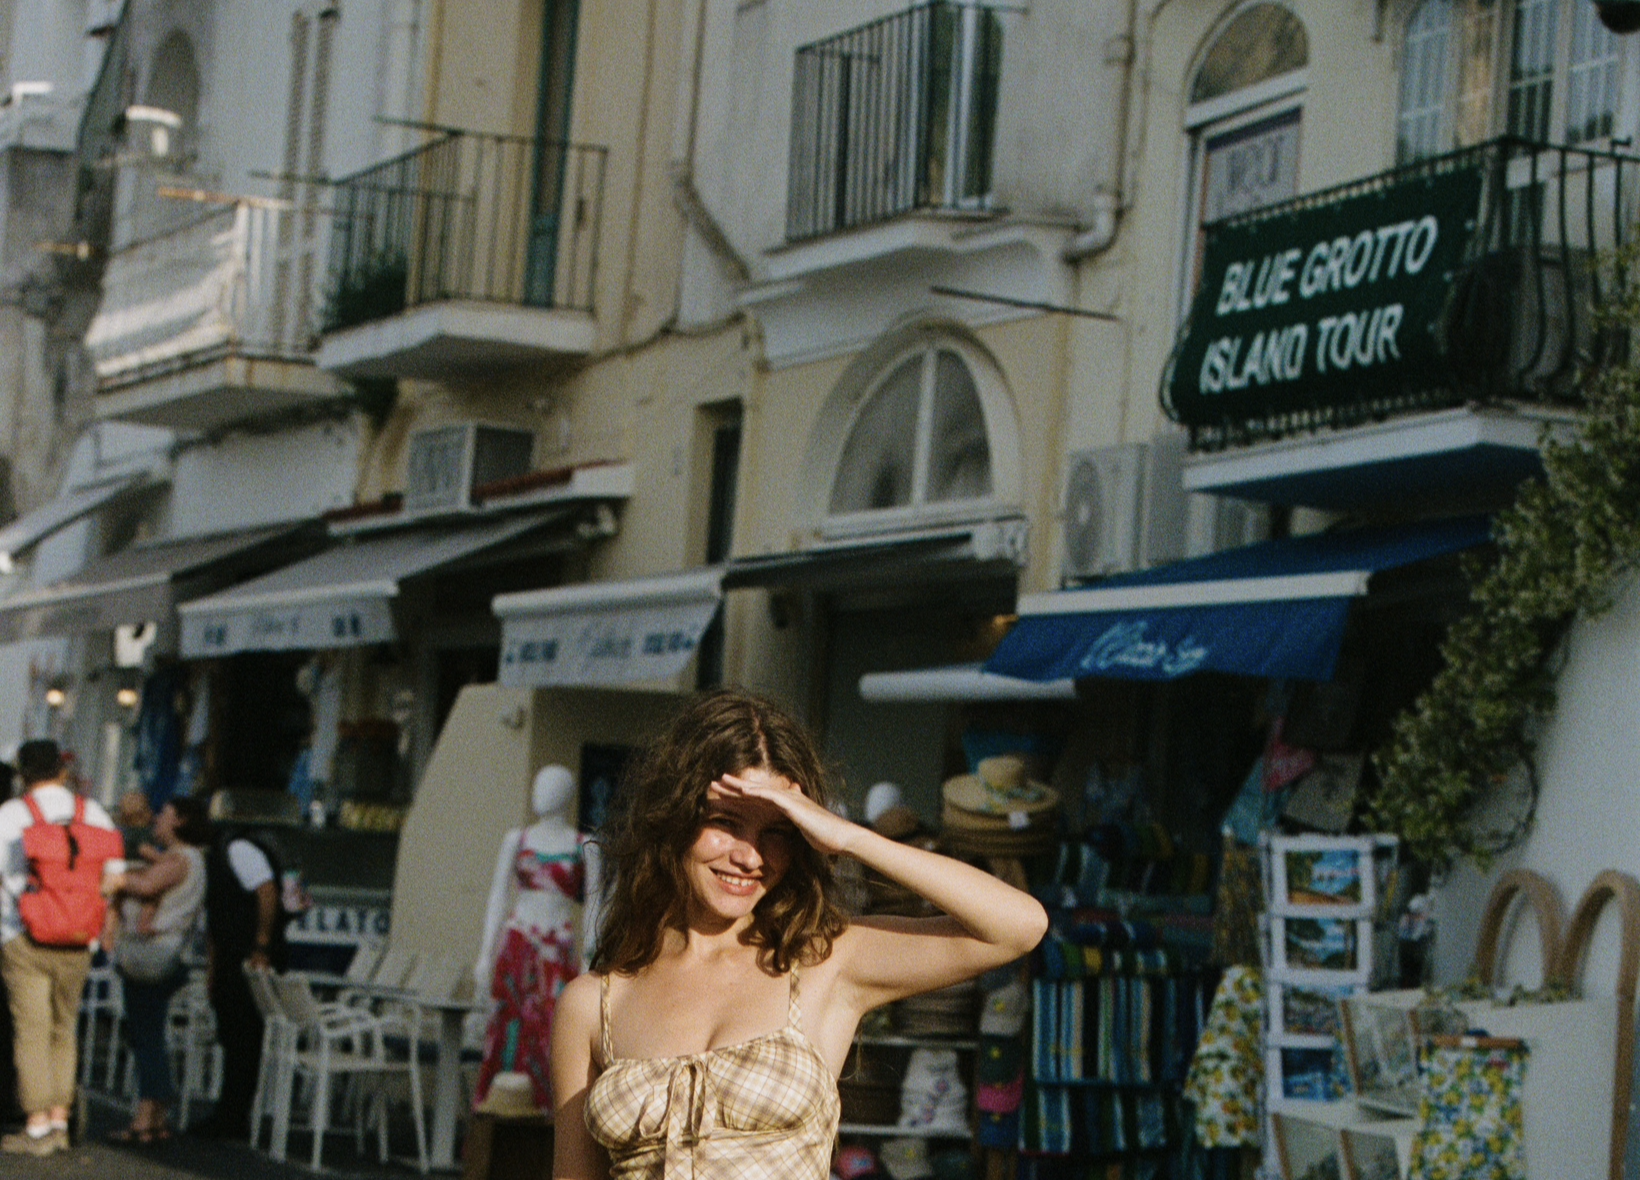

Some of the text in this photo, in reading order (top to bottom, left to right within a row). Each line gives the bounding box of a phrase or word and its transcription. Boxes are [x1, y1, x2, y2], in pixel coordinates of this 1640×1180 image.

[1215, 214, 1439, 317] BLUE GROTTO
[1199, 302, 1404, 394] ISLAND TOUR
[297, 905, 391, 936] ELATO
